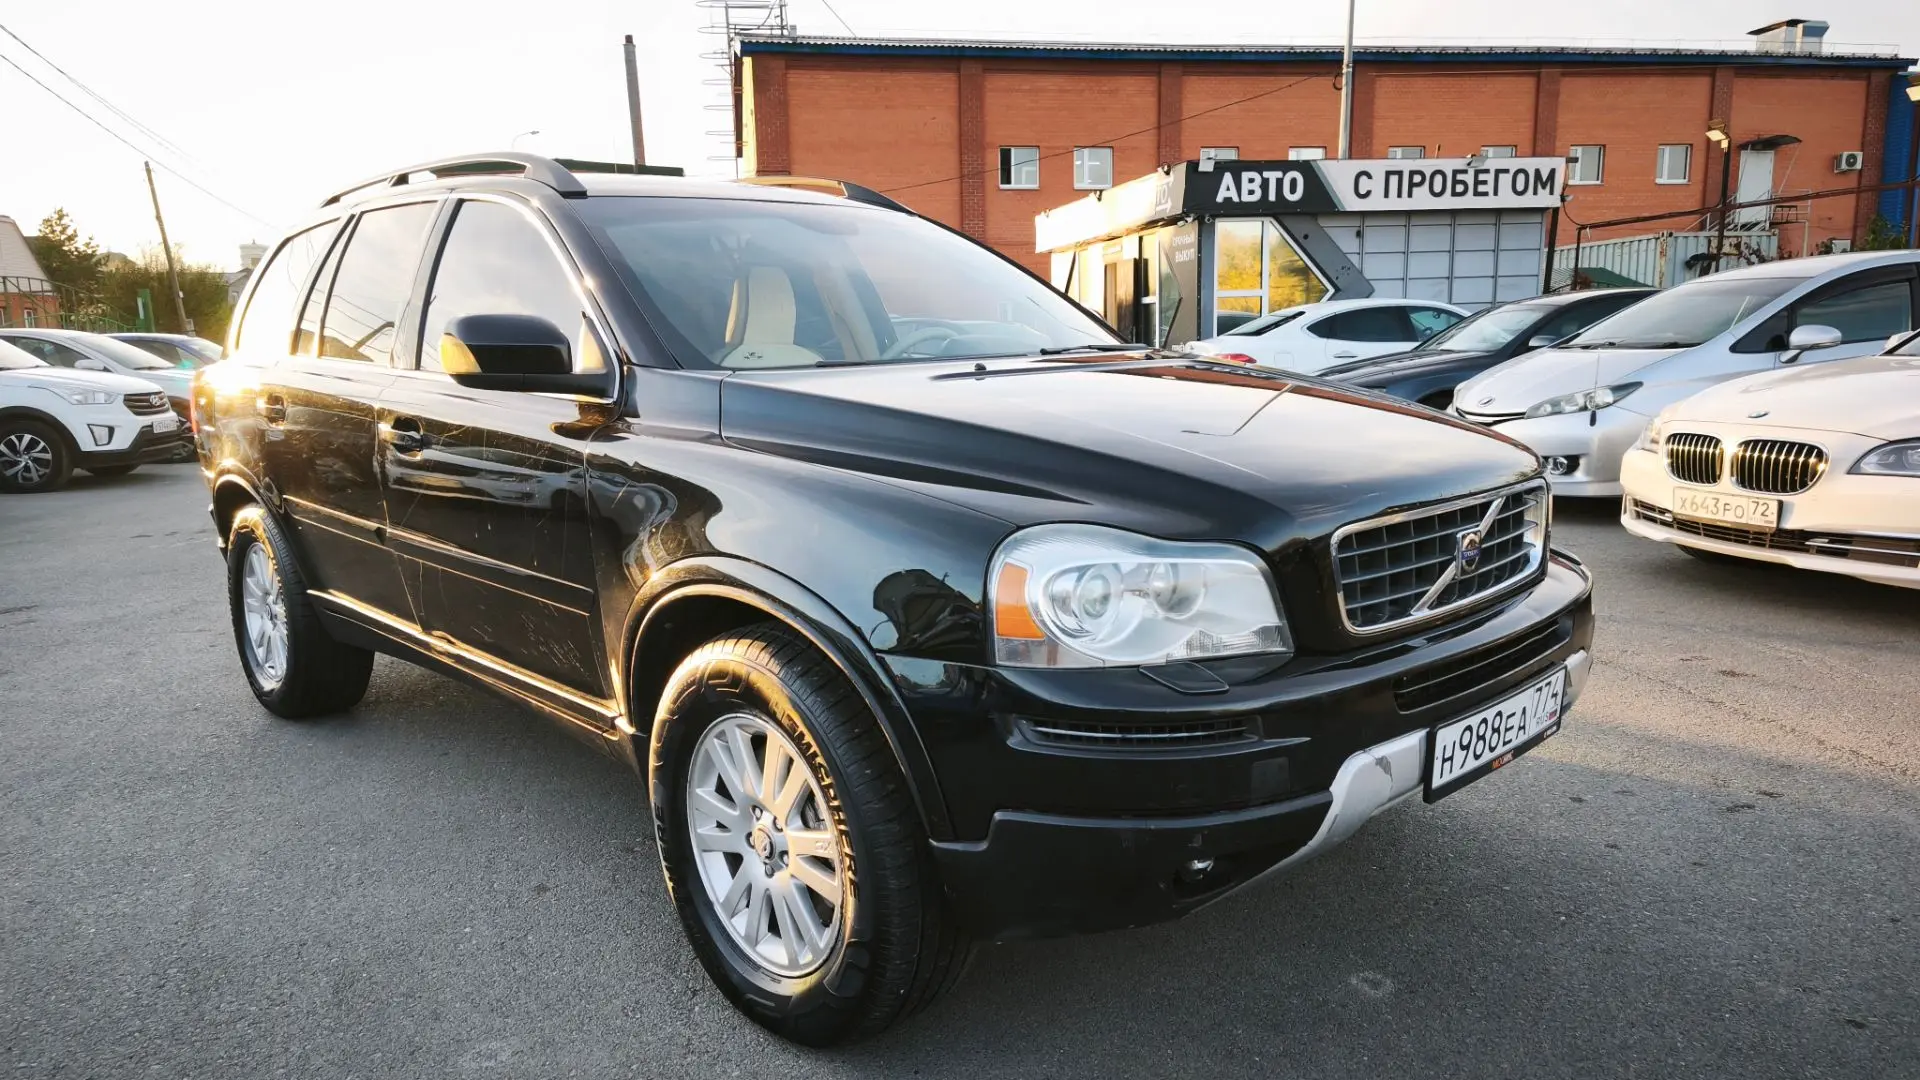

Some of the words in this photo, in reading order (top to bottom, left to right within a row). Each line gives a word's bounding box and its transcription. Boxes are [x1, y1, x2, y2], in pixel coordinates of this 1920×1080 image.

[1216, 171, 1304, 203] АВТО
[1354, 170, 1373, 199] С
[1384, 168, 1556, 199] ПРОБЕГОМ
[1751, 500, 1770, 517] 72
[1440, 706, 1528, 779] Н988ЕА
[1533, 676, 1560, 719] 774
